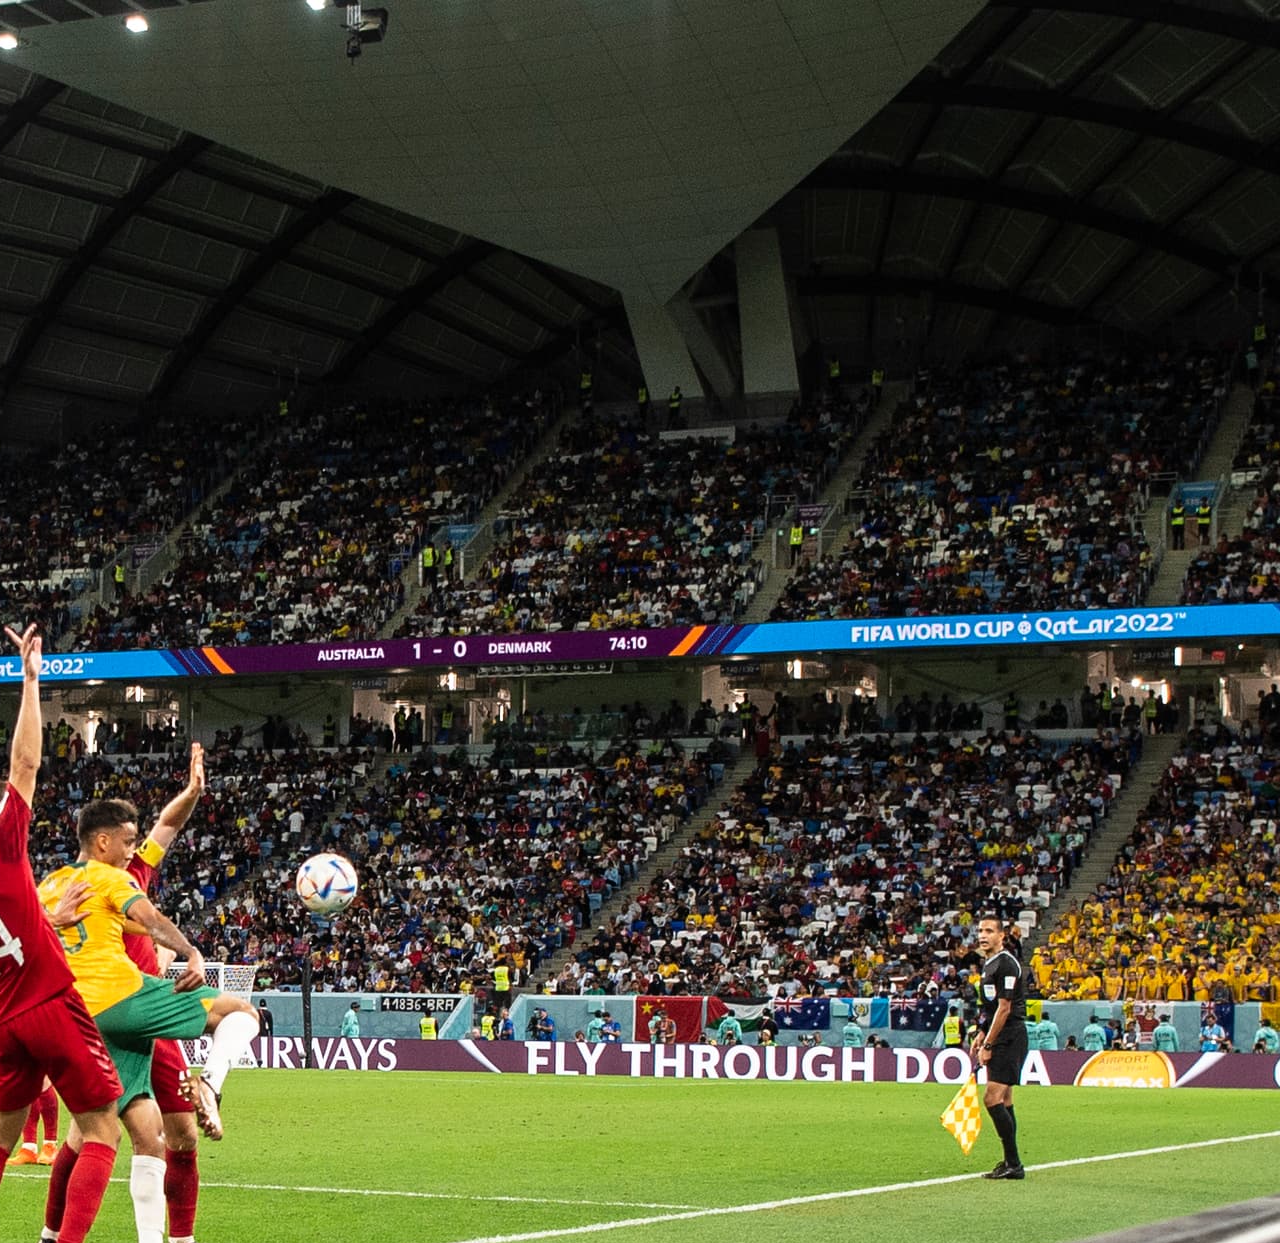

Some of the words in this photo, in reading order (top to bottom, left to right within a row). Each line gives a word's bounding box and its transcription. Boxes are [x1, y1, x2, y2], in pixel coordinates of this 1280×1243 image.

[851, 625, 894, 643] FIFA
[898, 622, 971, 641] WORLD
[974, 620, 1015, 638] CUP
[317, 647, 384, 662] AUSTRALIA
[453, 641, 467, 658] 0
[488, 641, 552, 655] DENMARK
[609, 636, 648, 651] 74:10
[524, 1041, 609, 1076] FLY
[621, 1043, 874, 1083] THROUGH
[893, 1048, 1051, 1087] DOA
